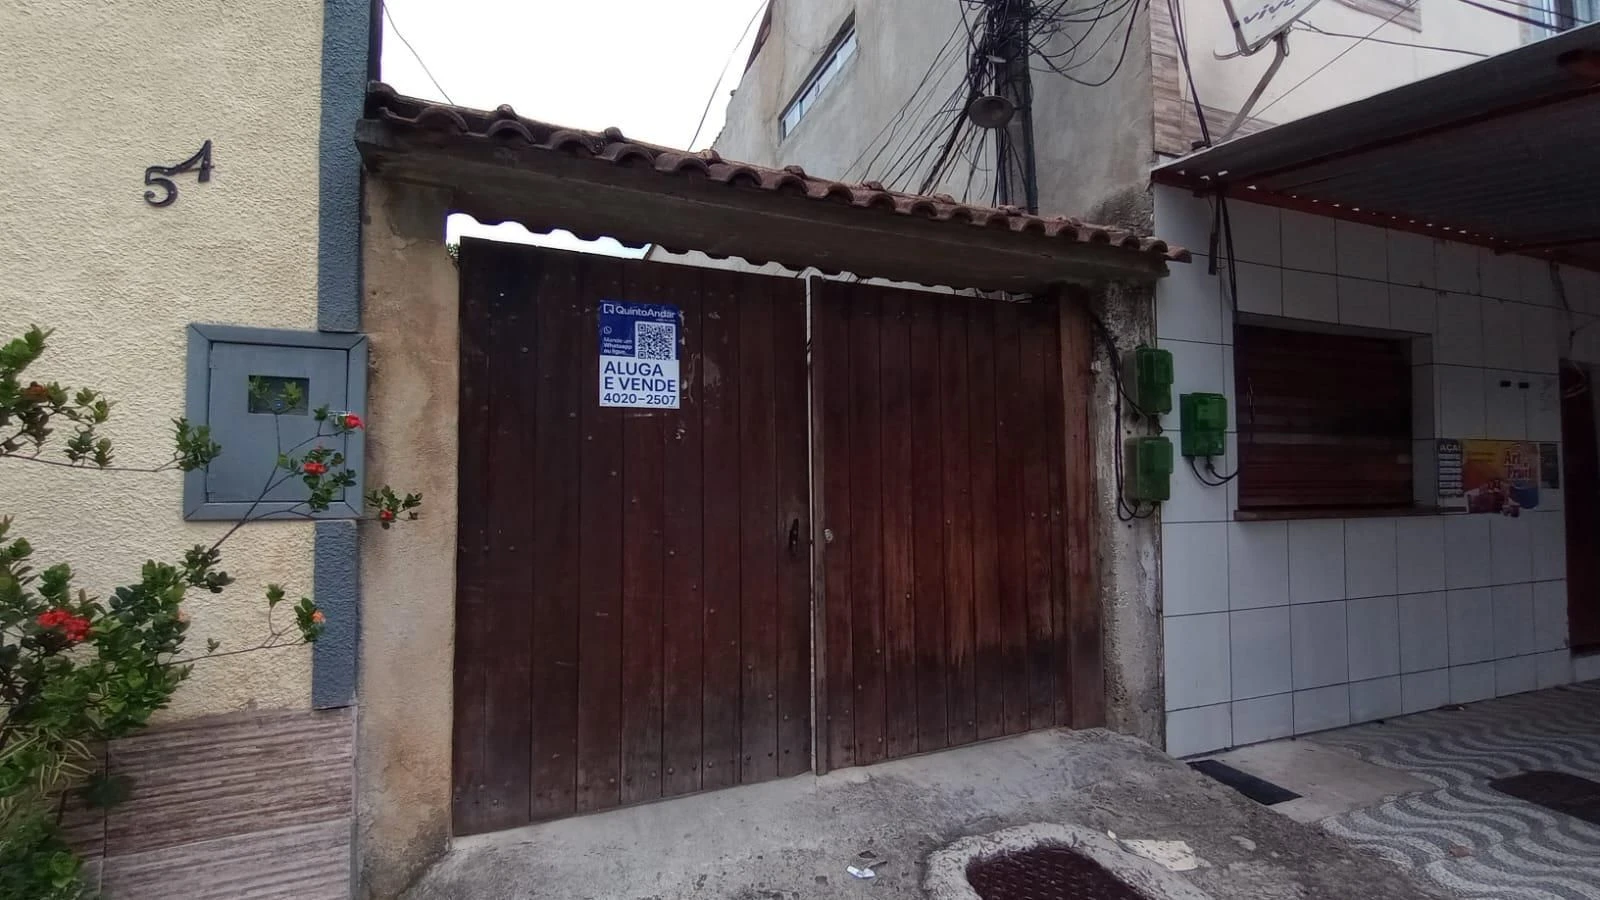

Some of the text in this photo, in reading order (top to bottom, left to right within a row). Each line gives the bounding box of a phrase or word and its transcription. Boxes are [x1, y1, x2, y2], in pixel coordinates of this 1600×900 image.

[144, 139, 215, 207] 54
[615, 305, 677, 319] QuintoAndar
[604, 361, 664, 377] ALUGA
[604, 376, 676, 392] E VENDE
[603, 393, 676, 405] 4020-2507
